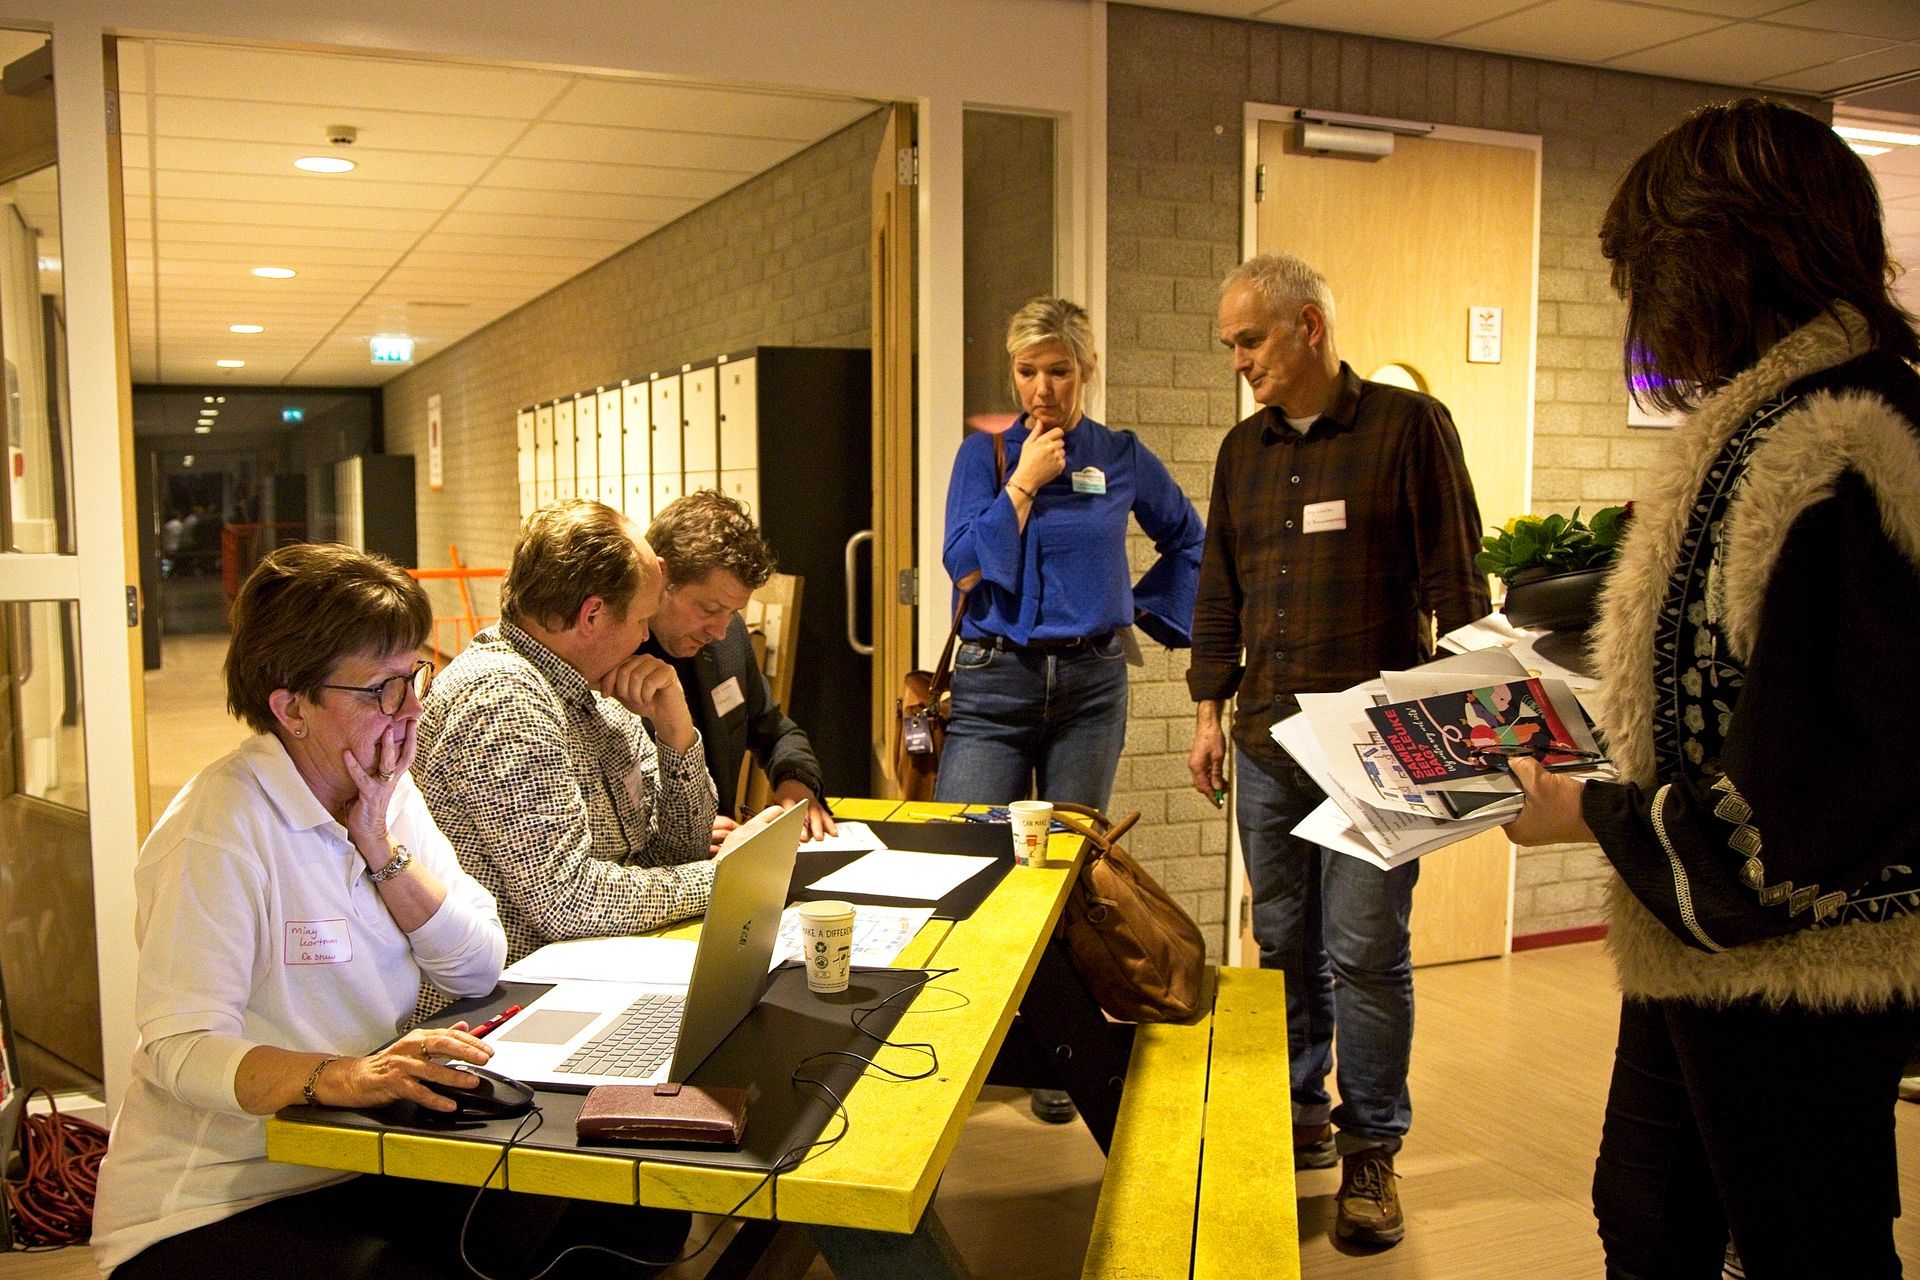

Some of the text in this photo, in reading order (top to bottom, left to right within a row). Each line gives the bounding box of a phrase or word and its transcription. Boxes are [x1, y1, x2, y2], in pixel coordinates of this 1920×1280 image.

[1384, 709, 1436, 777] EEN LEUKE
[1388, 735, 1424, 779] SAMEN
[1418, 744, 1448, 775] DAG?
[818, 930, 824, 938] A
